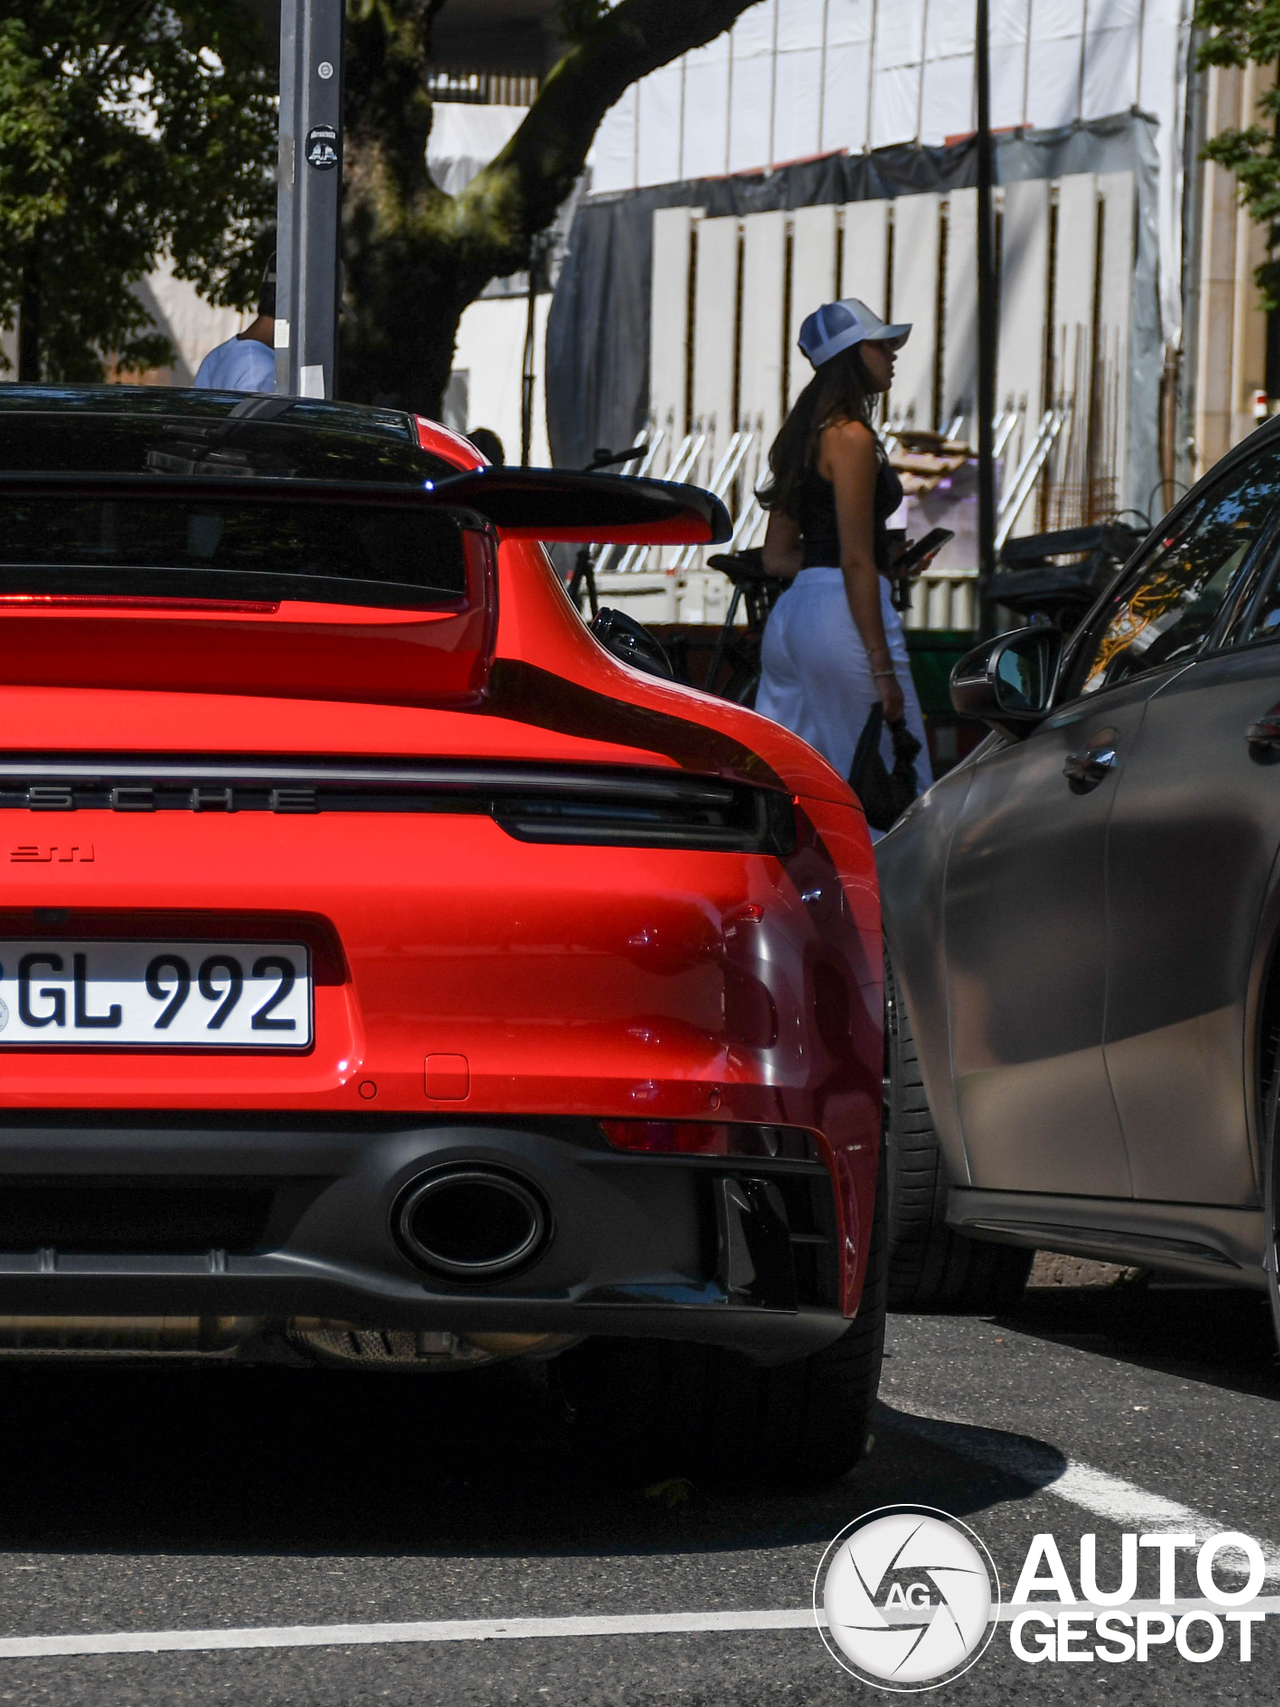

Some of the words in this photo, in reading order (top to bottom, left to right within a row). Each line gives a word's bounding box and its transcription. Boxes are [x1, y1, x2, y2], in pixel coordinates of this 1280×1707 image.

[9, 844, 95, 863] 911
[18, 953, 123, 1029] GL
[145, 955, 297, 1030] 992
